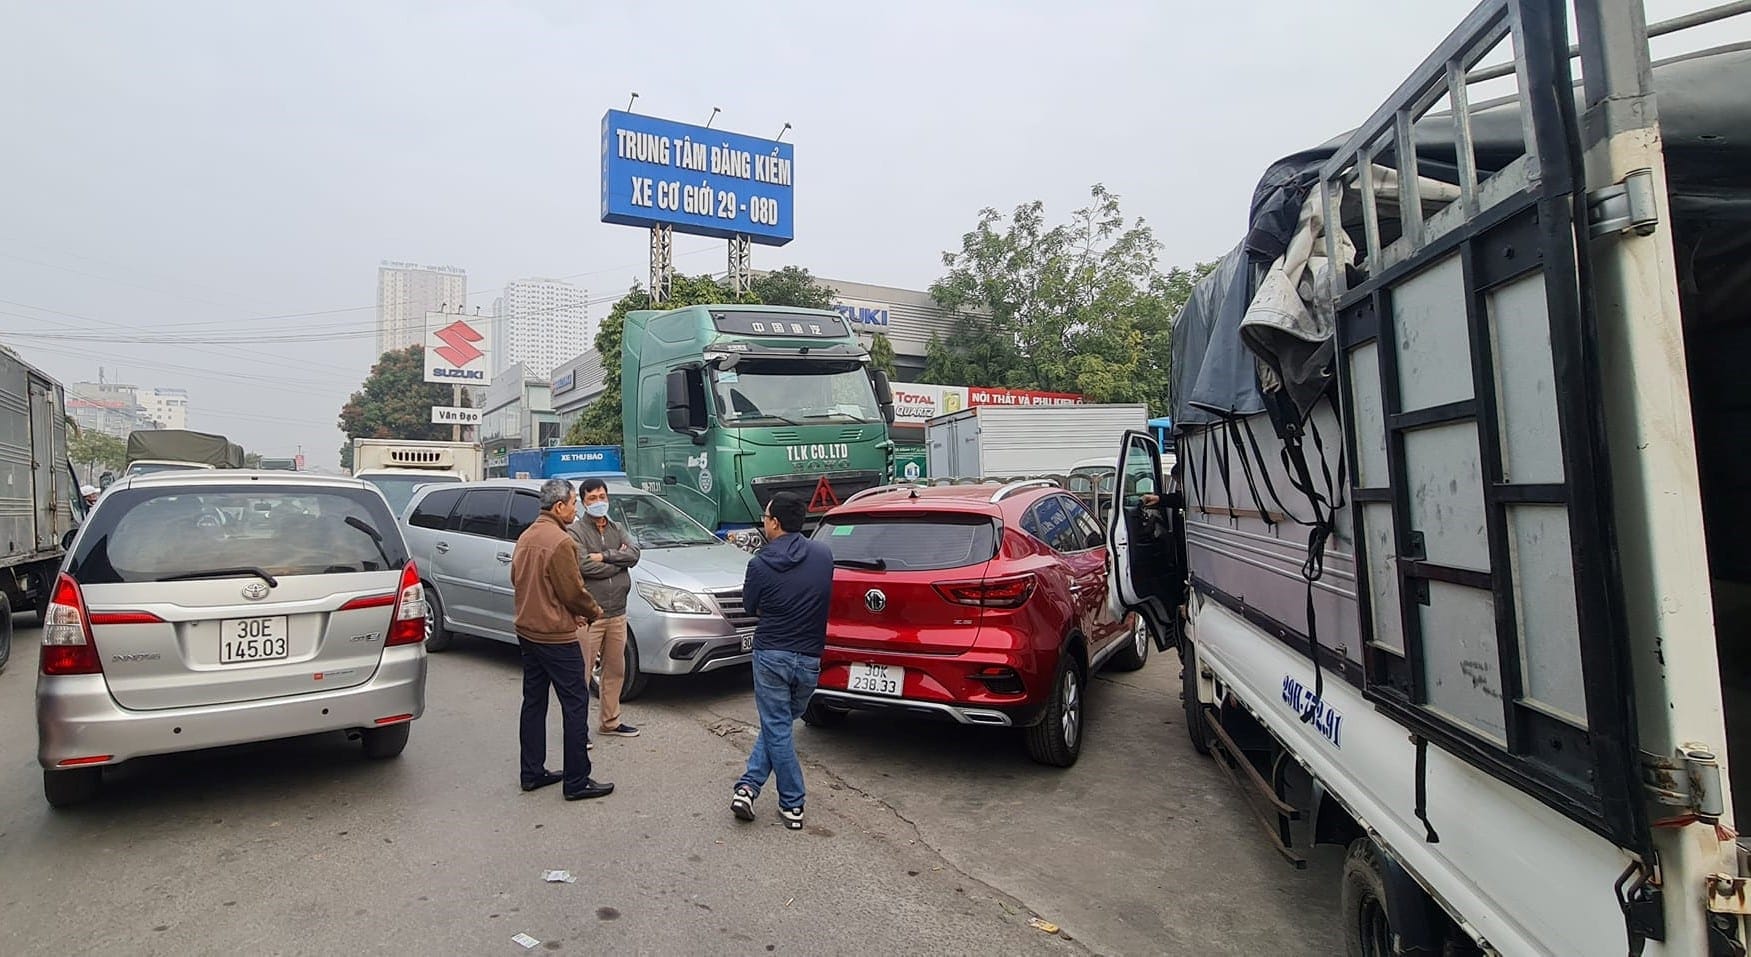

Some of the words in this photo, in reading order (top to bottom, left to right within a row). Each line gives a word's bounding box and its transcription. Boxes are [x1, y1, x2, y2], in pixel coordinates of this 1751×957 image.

[616, 128, 670, 166] TRUNG
[673, 135, 707, 172] TÂM
[710, 142, 751, 180] ĐĂNG
[754, 146, 792, 187] KIỂM
[631, 175, 653, 208] XE
[657, 180, 681, 212] CƠ
[683, 179, 715, 217] GIỚI
[717, 190, 737, 220] 29
[750, 196, 779, 227] 08D
[433, 368, 484, 380] SUZUKI
[895, 391, 935, 405] TOTAL
[895, 406, 936, 418] QUARTZ
[560, 453, 571, 462] XE
[786, 444, 808, 461] TLK
[236, 618, 273, 639] 30E
[225, 637, 286, 661] 145.03
[864, 663, 889, 679] 30K
[853, 676, 897, 694] 238.33
